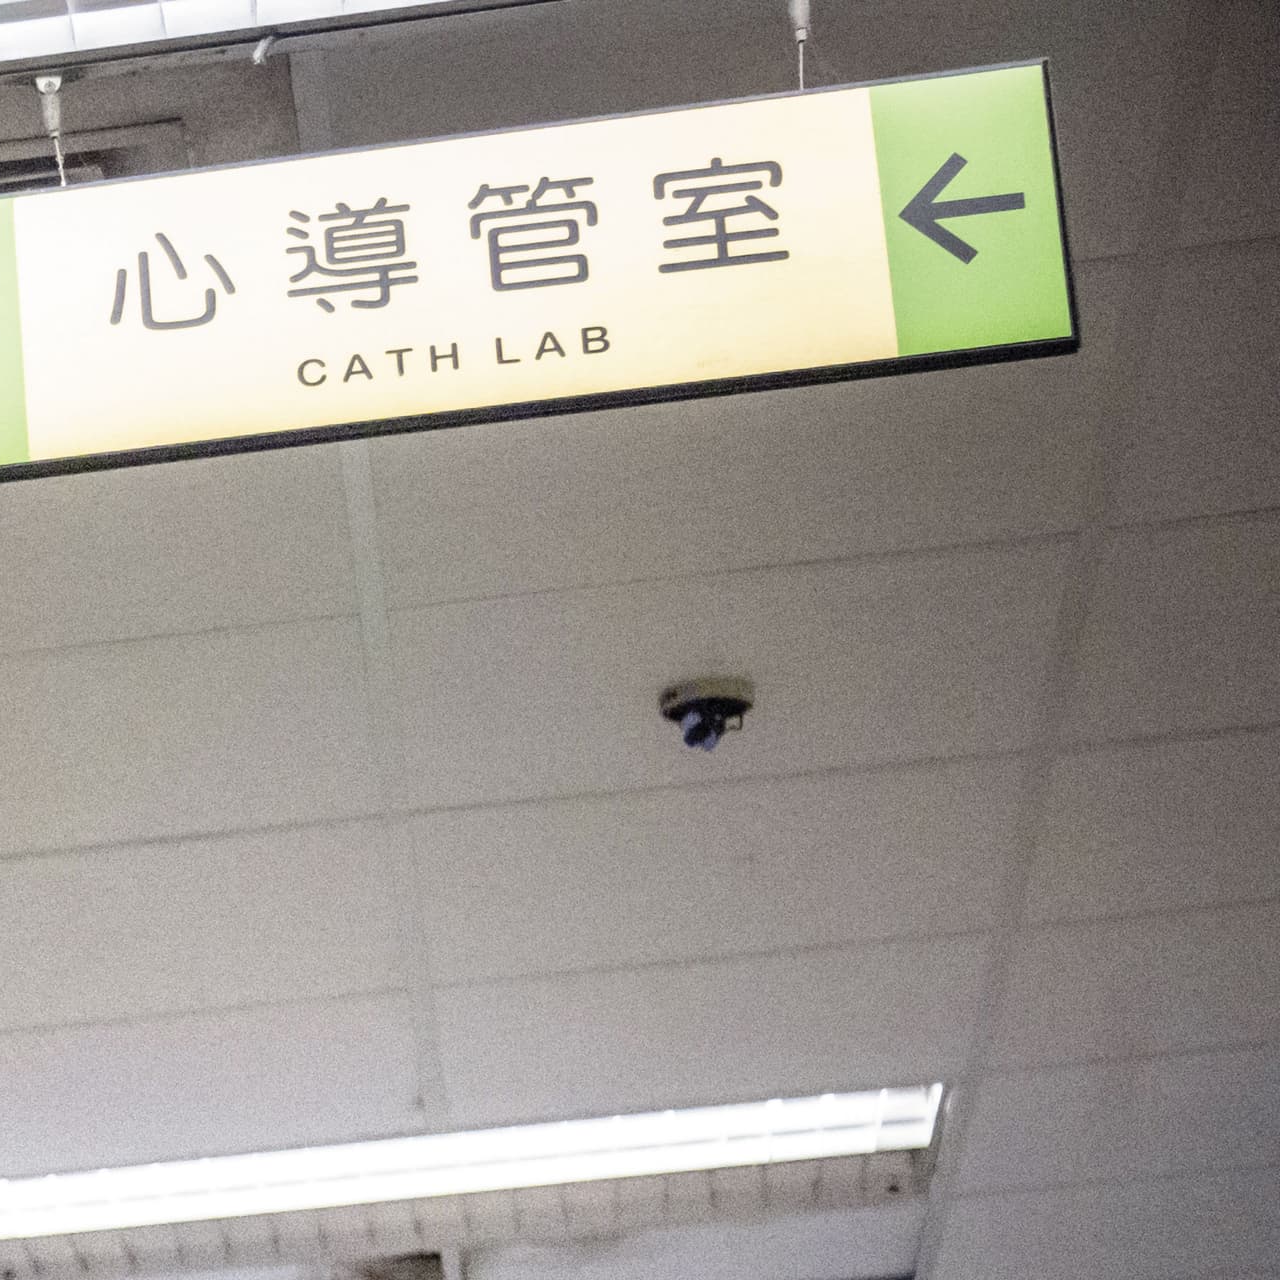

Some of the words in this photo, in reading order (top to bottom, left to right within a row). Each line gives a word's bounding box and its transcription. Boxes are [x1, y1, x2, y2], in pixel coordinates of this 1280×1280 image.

[109, 157, 790, 331] 心導管室
[296, 342, 460, 387] CATH
[494, 325, 611, 364] LAB
